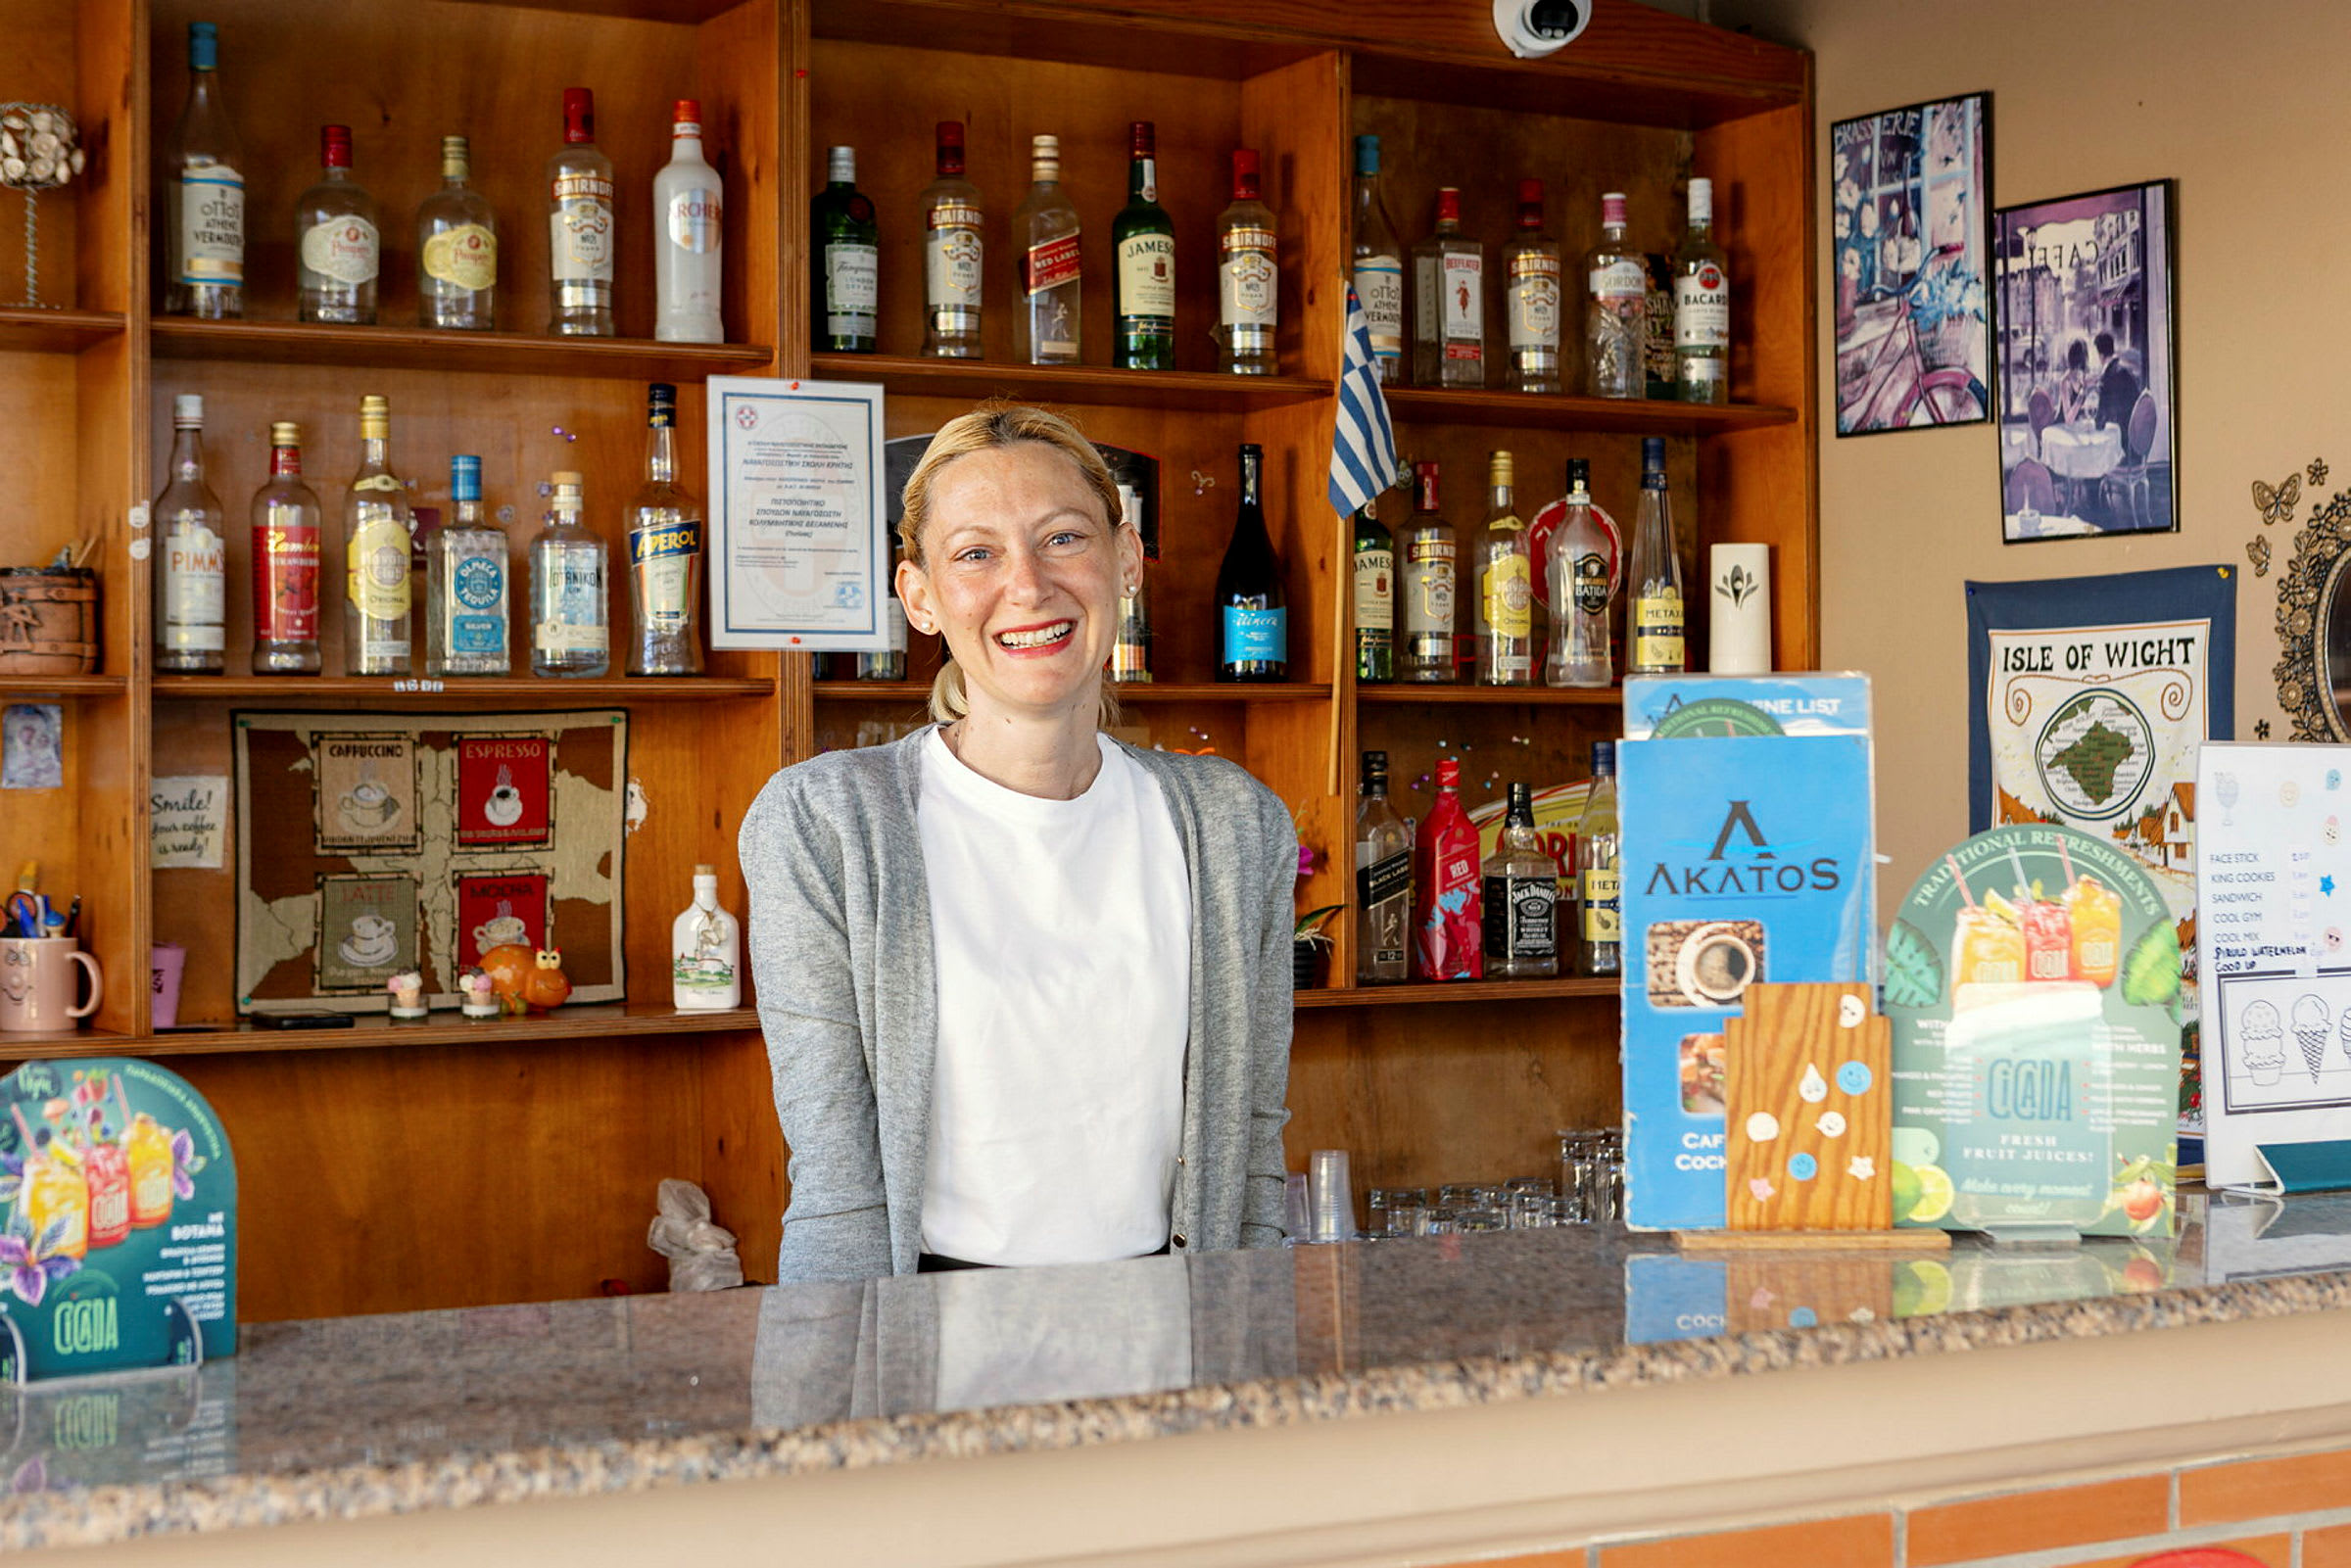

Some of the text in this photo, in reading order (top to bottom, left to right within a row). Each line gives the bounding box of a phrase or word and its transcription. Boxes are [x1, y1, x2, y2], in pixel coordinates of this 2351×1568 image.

[636, 530, 697, 559] APEROL
[459, 587, 499, 605] TEQUILA
[2003, 638, 2196, 672] ISLE OF WIGHT
[1796, 698, 1843, 717] LIST
[328, 742, 404, 759] CAPPUCCINO
[465, 742, 542, 759] ESPRESSO
[151, 788, 213, 815] Smile!
[2210, 853, 2232, 864] FACE
[1450, 859, 1469, 879] RED
[1912, 831, 2028, 909] TRADTIONAL
[2235, 871, 2276, 882] COOKIES
[470, 882, 535, 899] MOCHA
[2214, 912, 2240, 925] COOL
[2215, 932, 2241, 943] COOL
[1681, 1132, 1725, 1150] CAF
[1962, 1146, 2017, 1161] FRUIT
